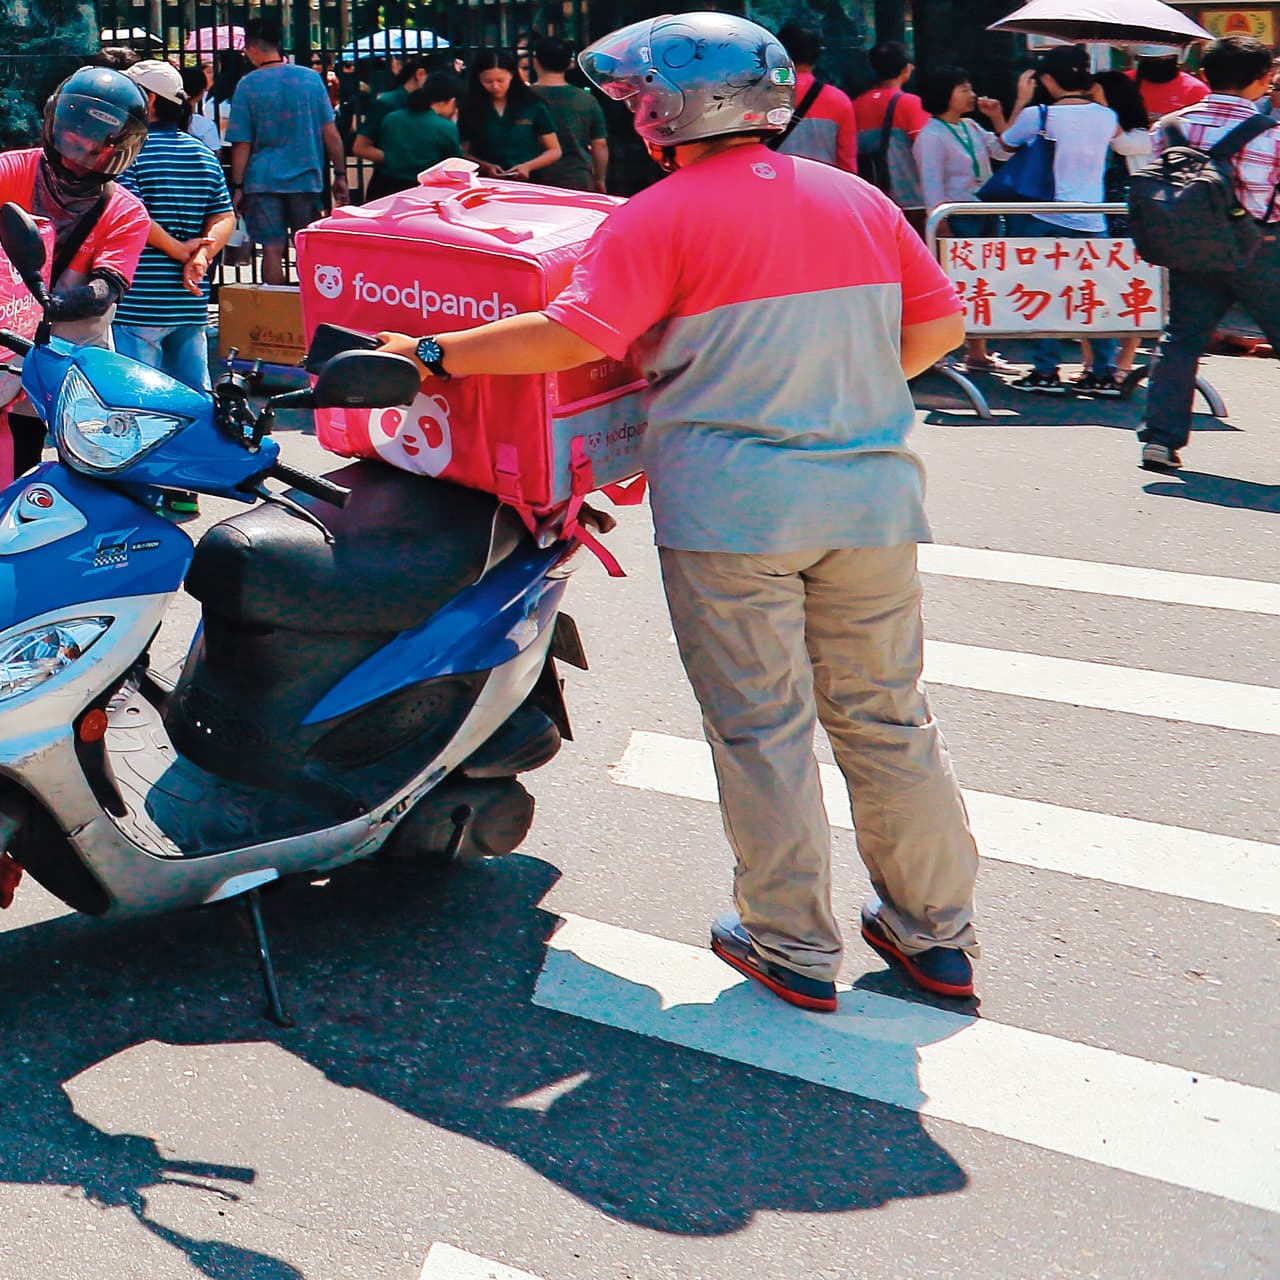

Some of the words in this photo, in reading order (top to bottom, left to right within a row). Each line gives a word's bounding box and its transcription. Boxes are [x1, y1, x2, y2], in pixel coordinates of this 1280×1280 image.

[352, 273, 518, 322] foodpanda
[954, 277, 1157, 327] 請勿停車
